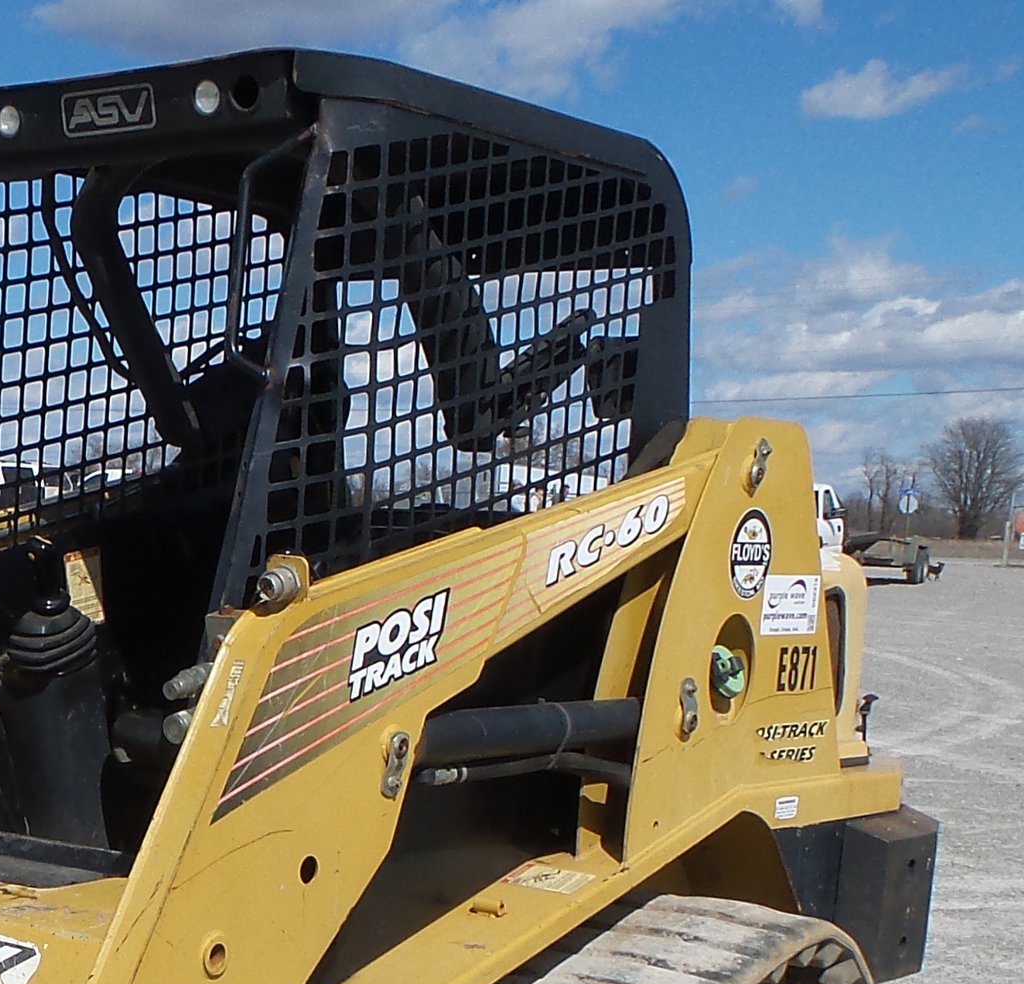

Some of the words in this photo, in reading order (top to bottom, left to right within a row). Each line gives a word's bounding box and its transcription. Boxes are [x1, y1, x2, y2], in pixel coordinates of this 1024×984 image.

[68, 90, 148, 129] ASV
[731, 543, 771, 562] FLOYD'S
[351, 587, 450, 673] POSI
[763, 610, 808, 622] purplewave.com
[348, 634, 438, 702] TRACK
[776, 645, 818, 692] E871
[755, 721, 828, 742] OSI-TRACK
[769, 746, 816, 762] SERIES
